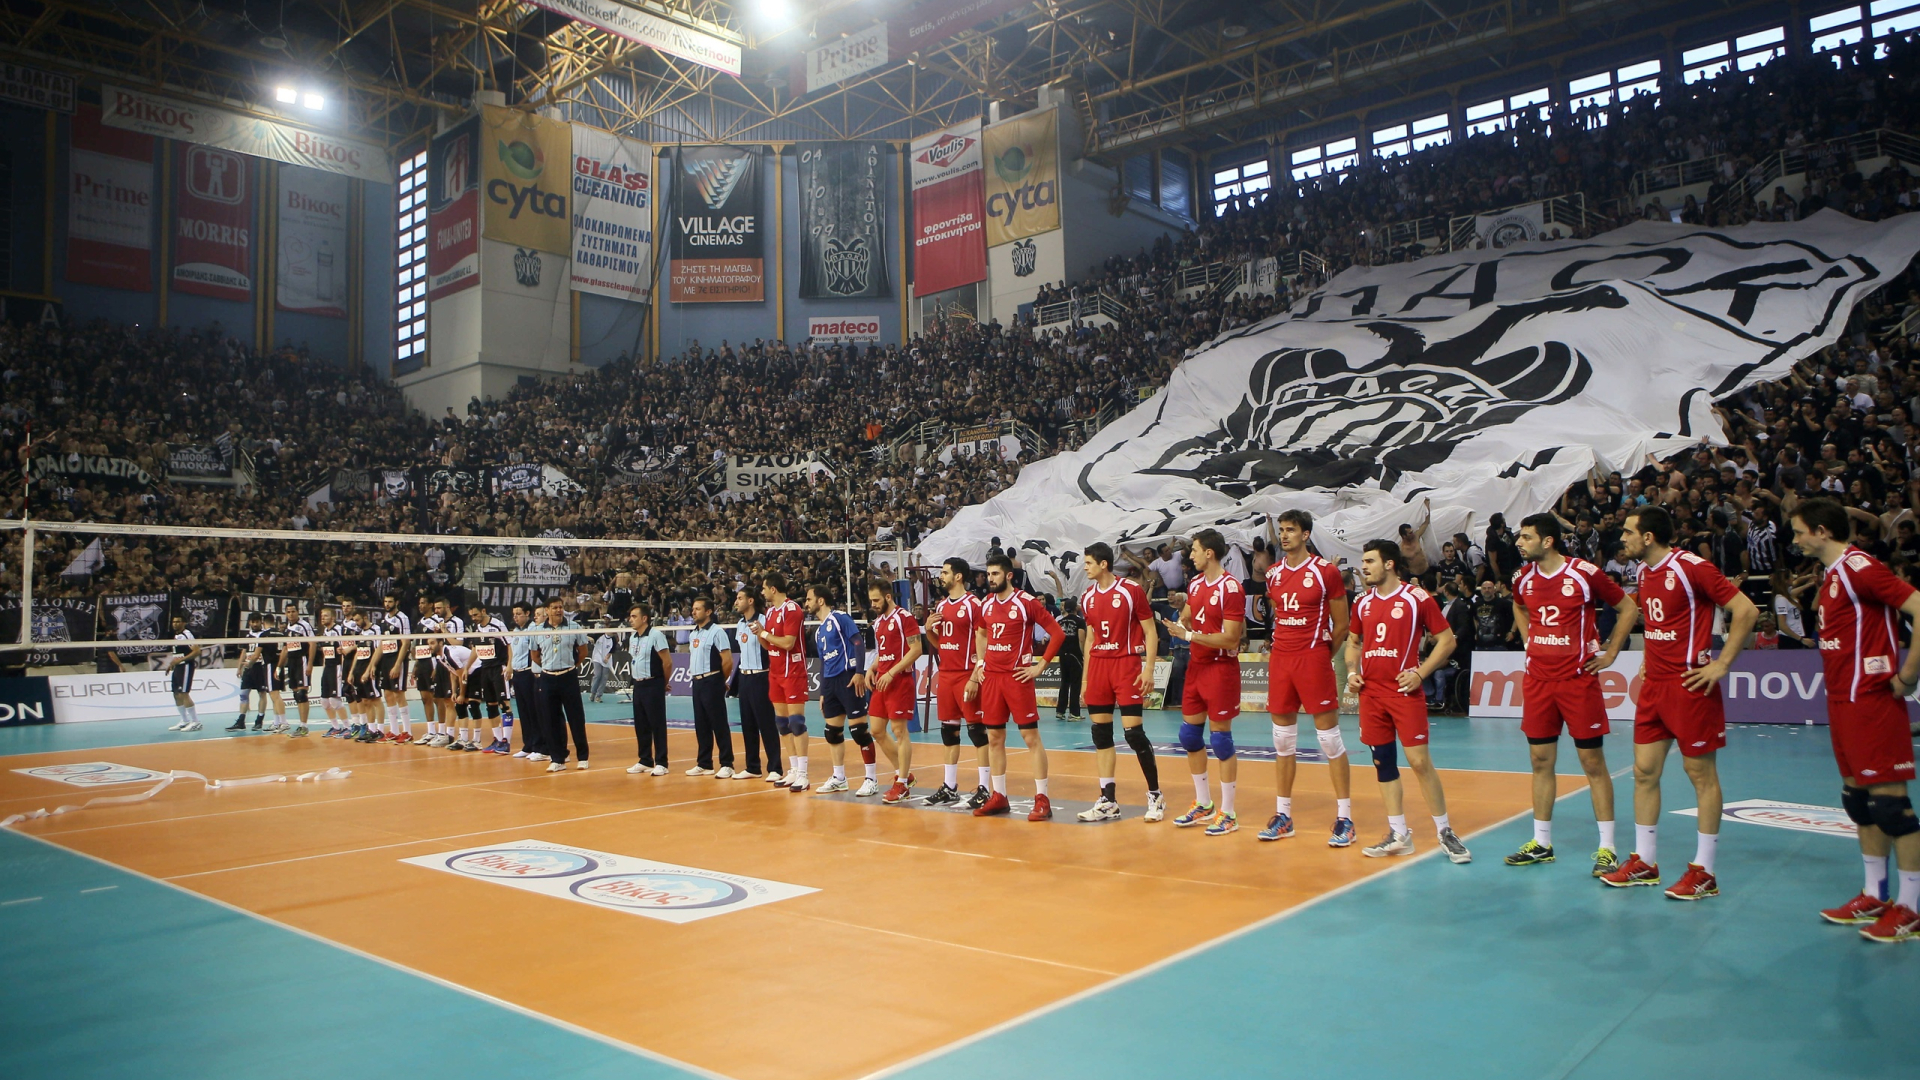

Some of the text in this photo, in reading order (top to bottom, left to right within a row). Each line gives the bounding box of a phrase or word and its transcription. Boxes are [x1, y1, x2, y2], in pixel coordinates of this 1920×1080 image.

[816, 35, 878, 74] Prime
[116, 91, 195, 134] Βίκος
[295, 131, 361, 170] Βίκος
[929, 138, 964, 163] Voulis
[576, 156, 649, 191] GLASS
[915, 160, 979, 185] www.voulis.com
[73, 172, 149, 206] Prime
[487, 178, 565, 219] cyta
[574, 176, 647, 208] CLEANING
[288, 190, 341, 218] Βίκος
[986, 179, 1055, 227] cyta
[178, 217, 249, 247] MORRIS
[573, 214, 651, 244] ΟΛΟΚΛΗΡΩΜΕΝΑ
[678, 216, 755, 235] VILLAGE
[916, 221, 982, 247] αυτοκινήτου
[923, 212, 973, 235] φροντίδα
[581, 234, 637, 258] ΣΥΣΤΗΜΑΤΑ
[689, 234, 744, 246] CINEMAS
[576, 250, 640, 275] ΚΑΘΑΡΙΣΜΟΥ
[681, 264, 753, 274] ΖΗΣΤΕ ΤΗ ΜΑΓΕΙΑ
[672, 275, 762, 285] ΤΟΥ ΚΙΝΗΜΑΤΟΓΡΑΦΟΥ
[683, 286, 696, 295] ΜΕ
[811, 320, 879, 335] mateco
[959, 425, 1002, 437] ΛΕΚΑΝΟΠΕΟΥ
[170, 452, 220, 462] ΣΑΜΟΘΡΑ
[106, 593, 168, 606] ΕΠΑΝΟΜΗ
[481, 586, 562, 607] PANORM
[1281, 592, 1300, 611] 14
[1195, 606, 1206, 624] 4
[1537, 605, 1561, 627] 12
[1645, 597, 1664, 623] 18
[941, 621, 953, 637] 10
[991, 623, 1005, 639] 17
[1101, 620, 1109, 638] 5
[1375, 622, 1387, 642] 9
[821, 635, 827, 651] 7
[879, 635, 886, 650] 2
[1818, 637, 1842, 651] ibet
[25, 653, 59, 663] 1991
[1256, 668, 1265, 677] &
[54, 678, 220, 698] EUROMEDCA
[466, 854, 545, 876] Βίκος
[587, 880, 690, 905] Βίκος
